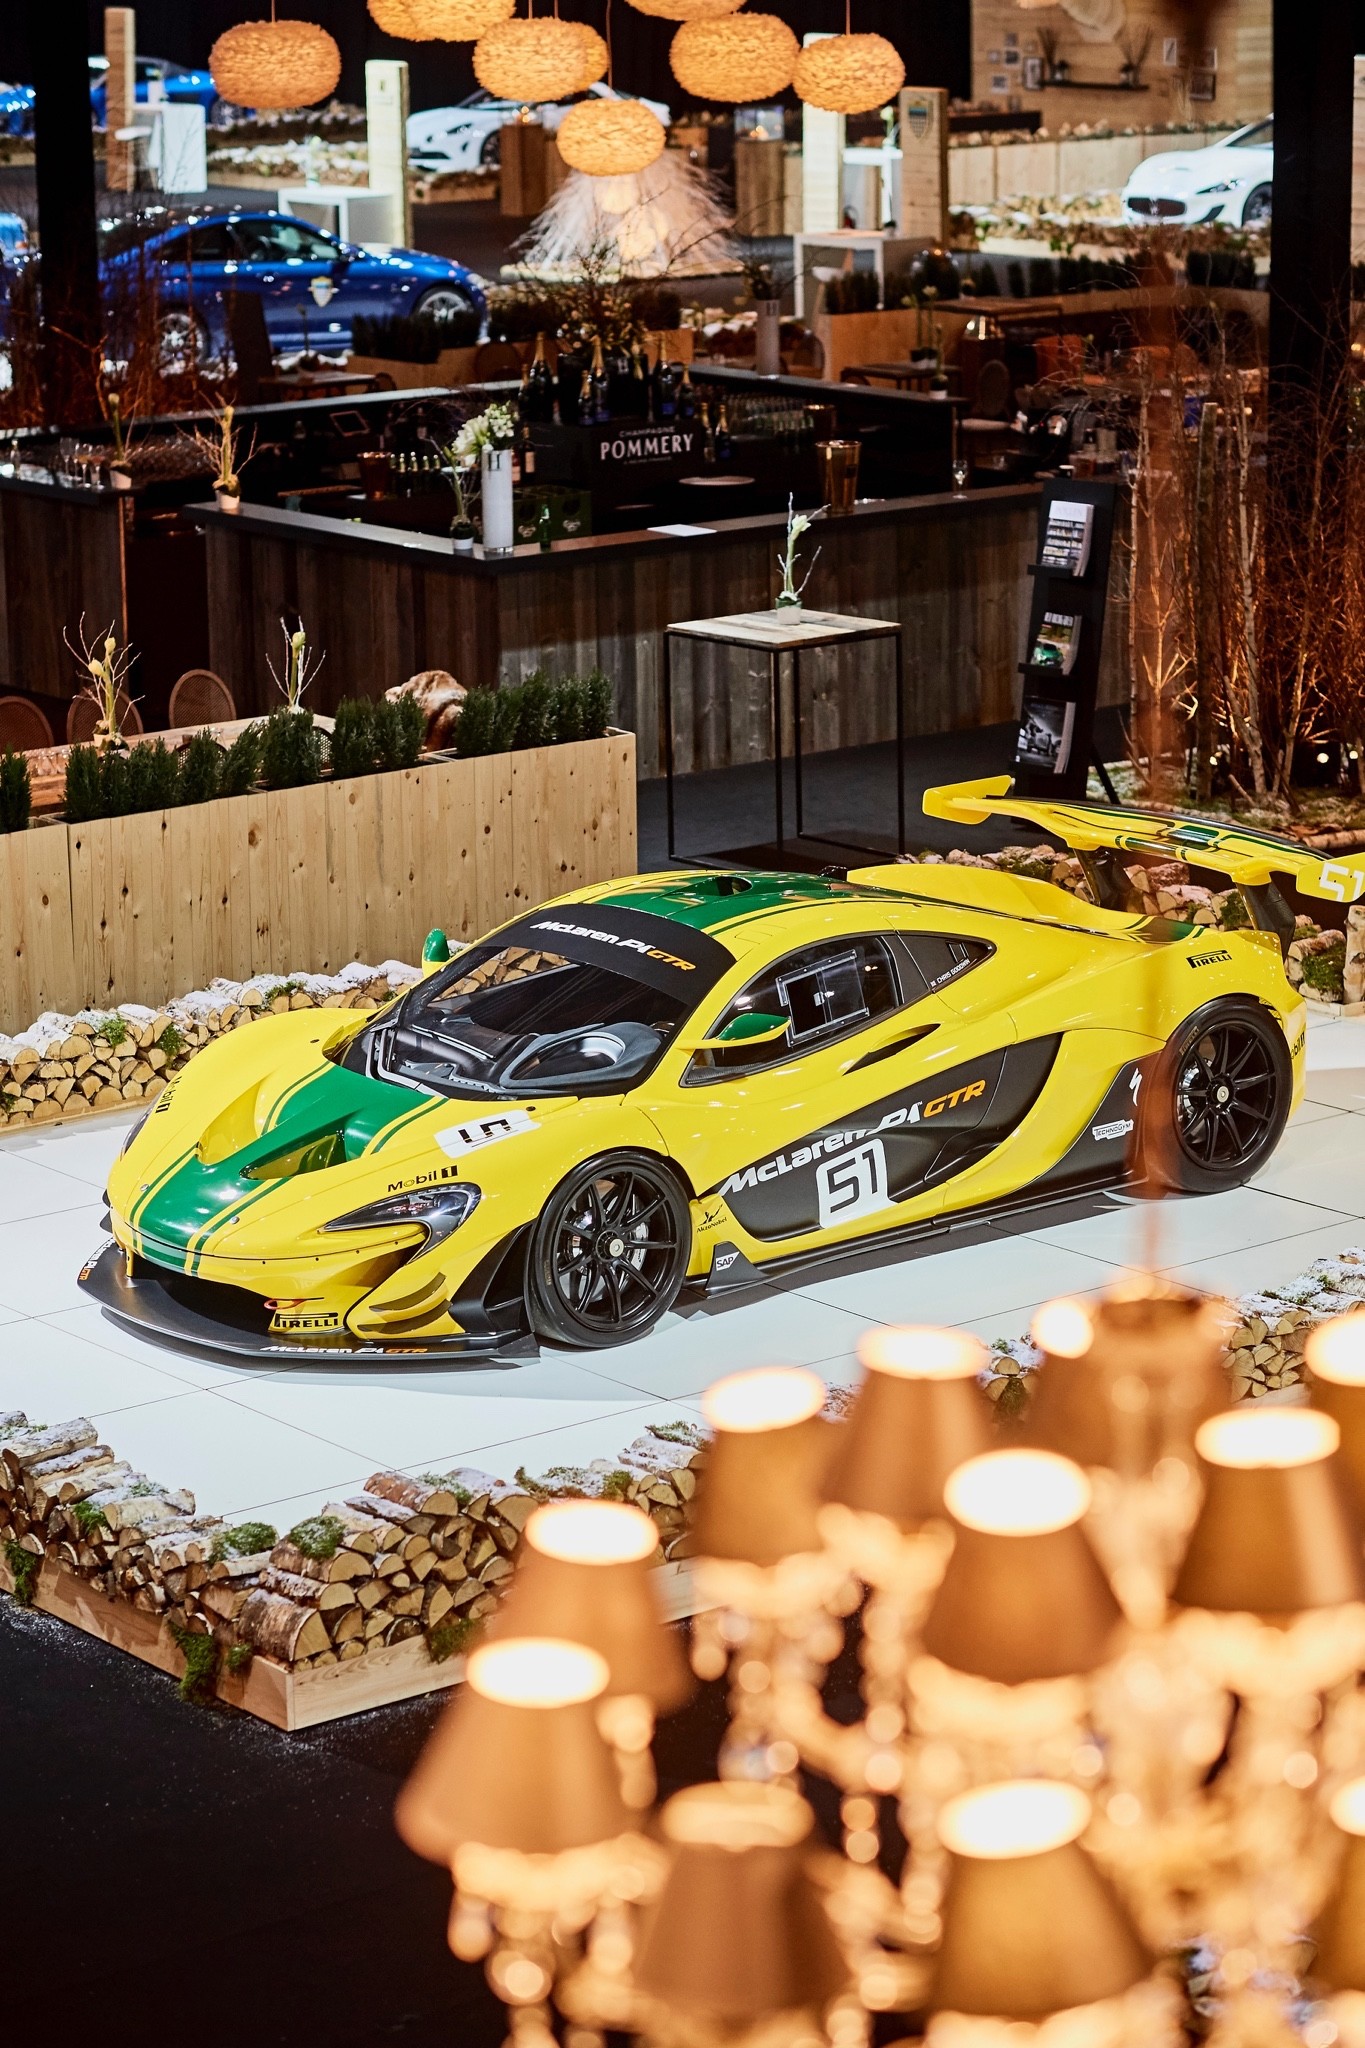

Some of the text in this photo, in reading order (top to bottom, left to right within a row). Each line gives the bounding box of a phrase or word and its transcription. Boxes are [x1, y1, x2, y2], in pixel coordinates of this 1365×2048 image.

[619, 426, 675, 437] CHAMPAGNE
[600, 433, 694, 460] POMMERY
[1319, 862, 1365, 902] 51
[529, 921, 620, 945] McLaren
[647, 949, 697, 971] GTR
[1186, 949, 1233, 969] PIRELLI
[936, 958, 971, 984] CHRIS GOODWIN
[718, 1129, 868, 1197] McLaren
[923, 1079, 987, 1118] GTR
[387, 1165, 459, 1192] Mobil 1
[823, 1145, 884, 1219] 51
[697, 1216, 728, 1233] AkzoNobel
[716, 1256, 734, 1269] SAP
[273, 1312, 339, 1328] PIRELLI
[259, 1345, 352, 1354] McLaren
